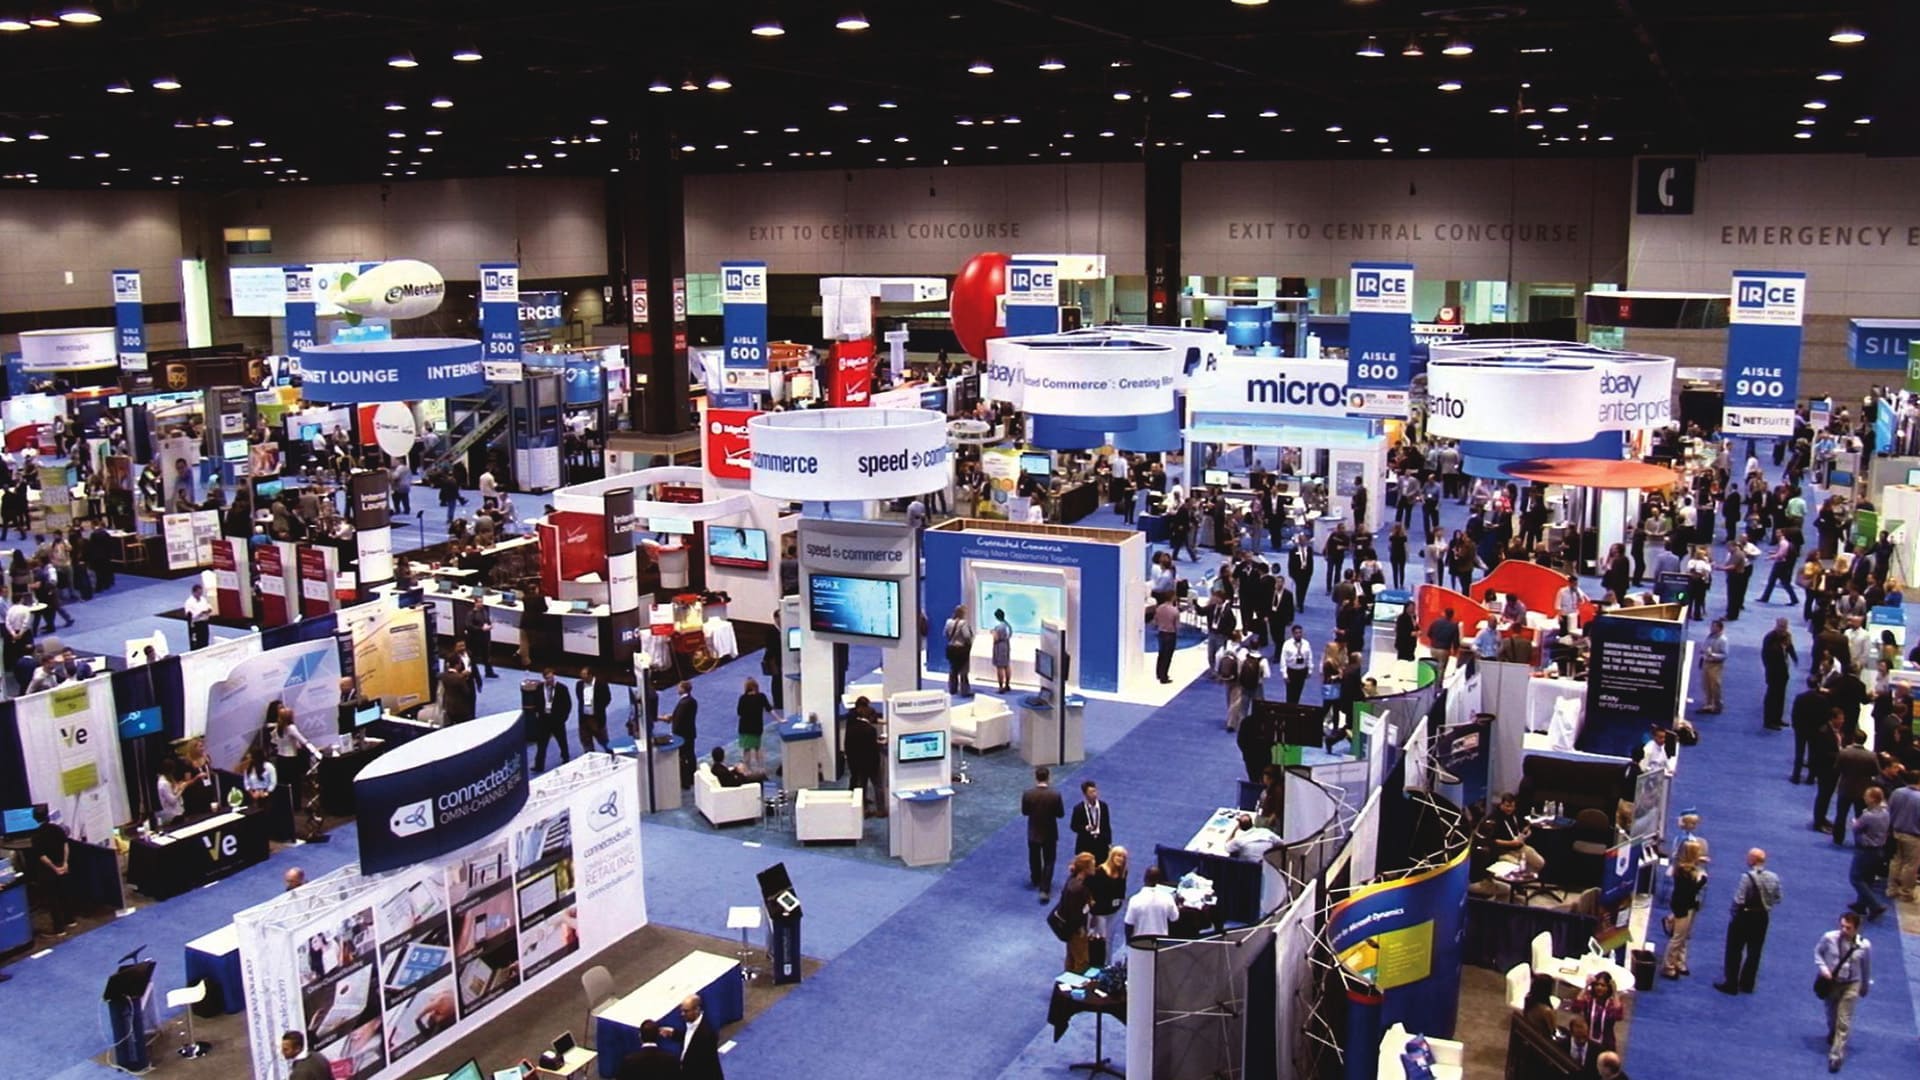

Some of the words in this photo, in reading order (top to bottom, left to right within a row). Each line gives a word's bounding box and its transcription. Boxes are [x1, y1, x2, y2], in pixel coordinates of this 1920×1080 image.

[749, 224, 785, 241] EXIT
[791, 224, 812, 240] TO
[820, 223, 897, 240] CENTRAL
[907, 222, 1020, 240] CONCOURSE
[1228, 222, 1276, 240] EXIT
[1285, 222, 1311, 240] TO
[1322, 222, 1423, 241] CENTRAL
[1434, 222, 1579, 242] CONCOURSE
[1720, 225, 1892, 247] EMERGENCY
[484, 273, 514, 288] IRCE
[728, 272, 761, 288] IRCE
[1012, 271, 1054, 289] IRCE
[1358, 275, 1407, 294] IRCE
[1739, 284, 1796, 305] IRCE
[491, 332, 513, 340] AISLE
[732, 336, 759, 345] AISLE
[489, 341, 515, 355] 500
[730, 346, 761, 361] 600
[1361, 351, 1397, 361] AISLE
[330, 368, 399, 384] LOUNGE
[1357, 363, 1399, 380] 800
[1740, 366, 1783, 378] AISLE
[1599, 370, 1642, 398] ebay
[1735, 379, 1785, 398] 900
[1742, 414, 1791, 427] NETSUITE
[858, 448, 909, 478] speed
[806, 543, 831, 559] speed
[841, 548, 903, 562] commerce
[60, 725, 88, 748] Ve
[202, 831, 238, 861] Ve
